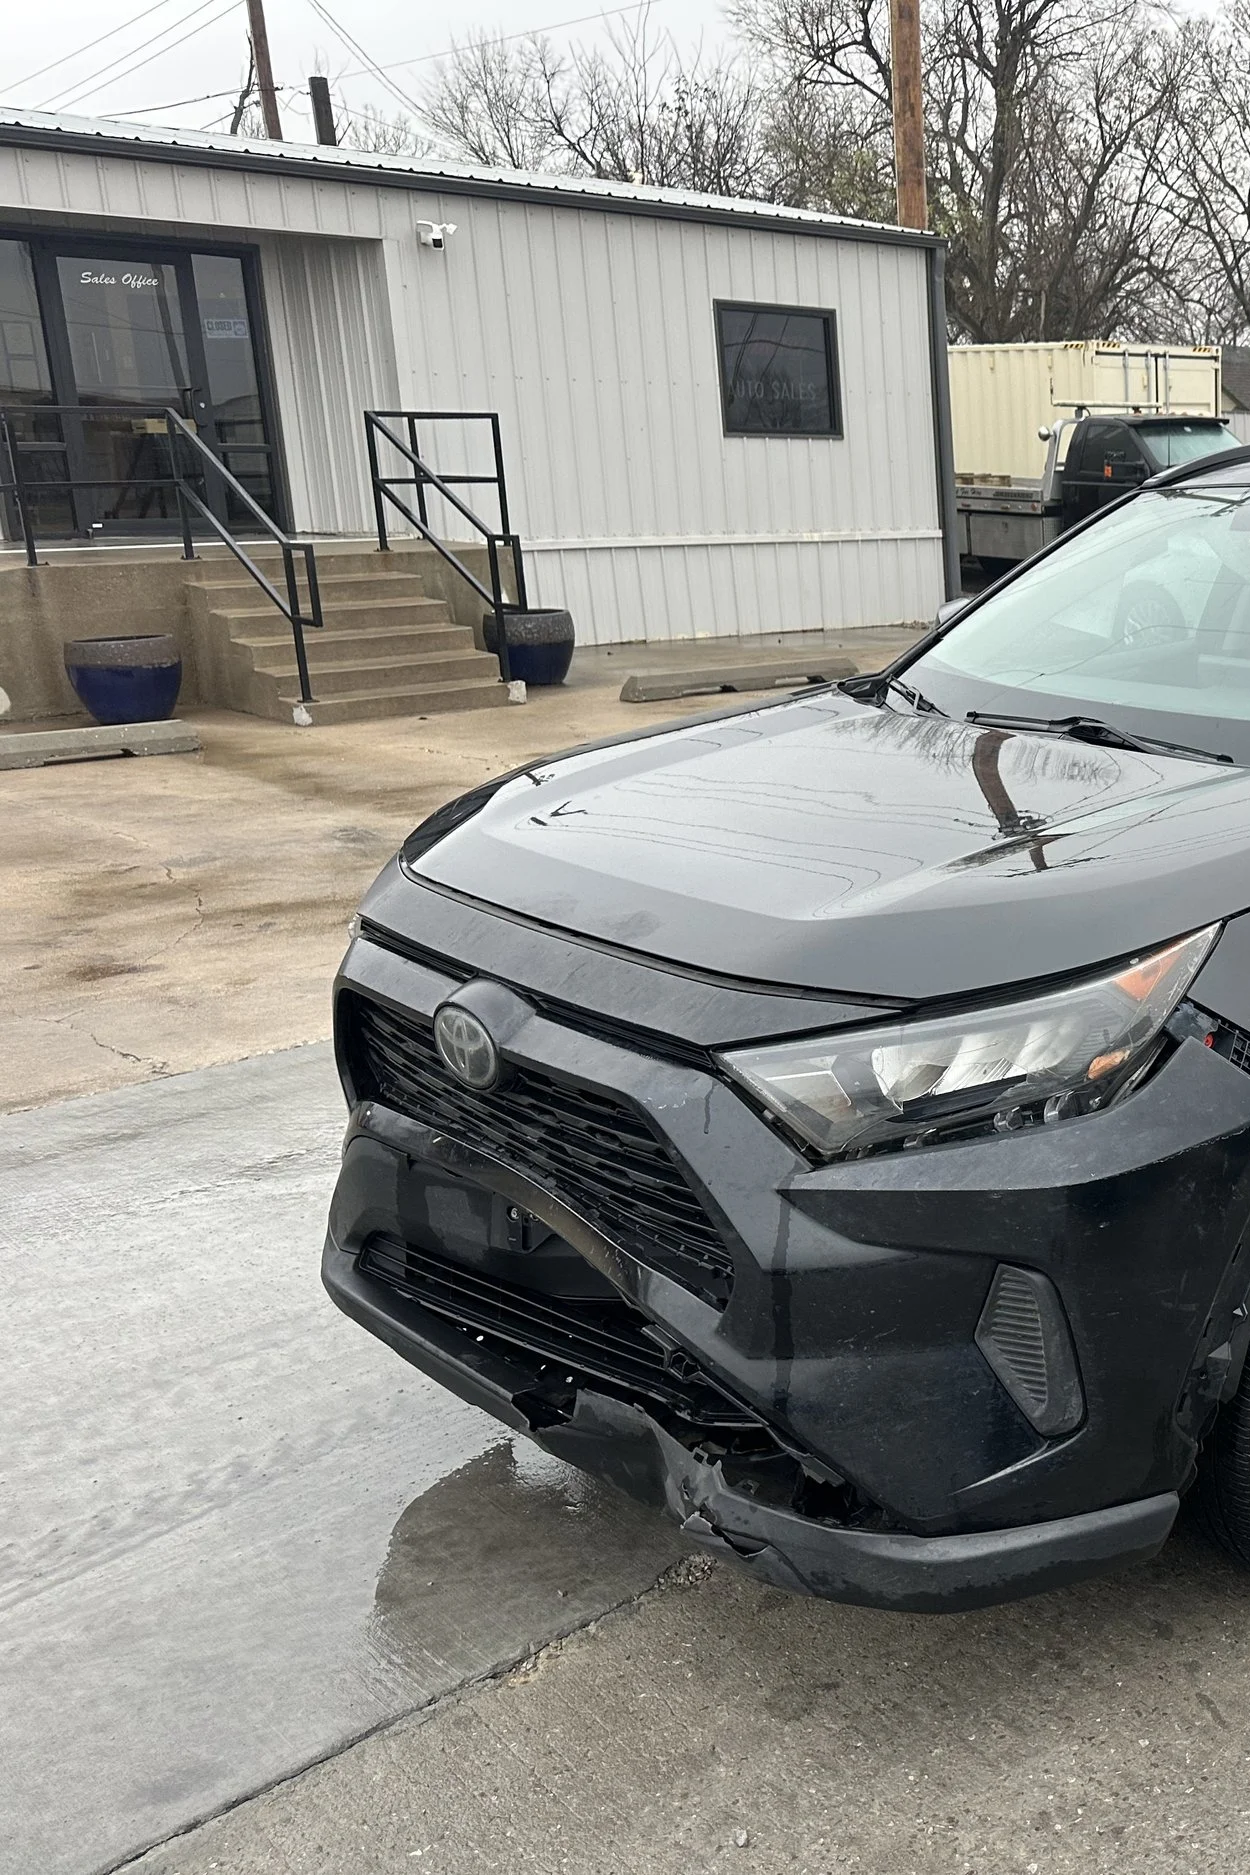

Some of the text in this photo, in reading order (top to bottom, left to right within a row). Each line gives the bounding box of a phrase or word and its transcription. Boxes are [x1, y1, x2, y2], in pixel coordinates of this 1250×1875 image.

[80, 271, 159, 289] Sales Office
[727, 379, 817, 400] AUTO SALES
